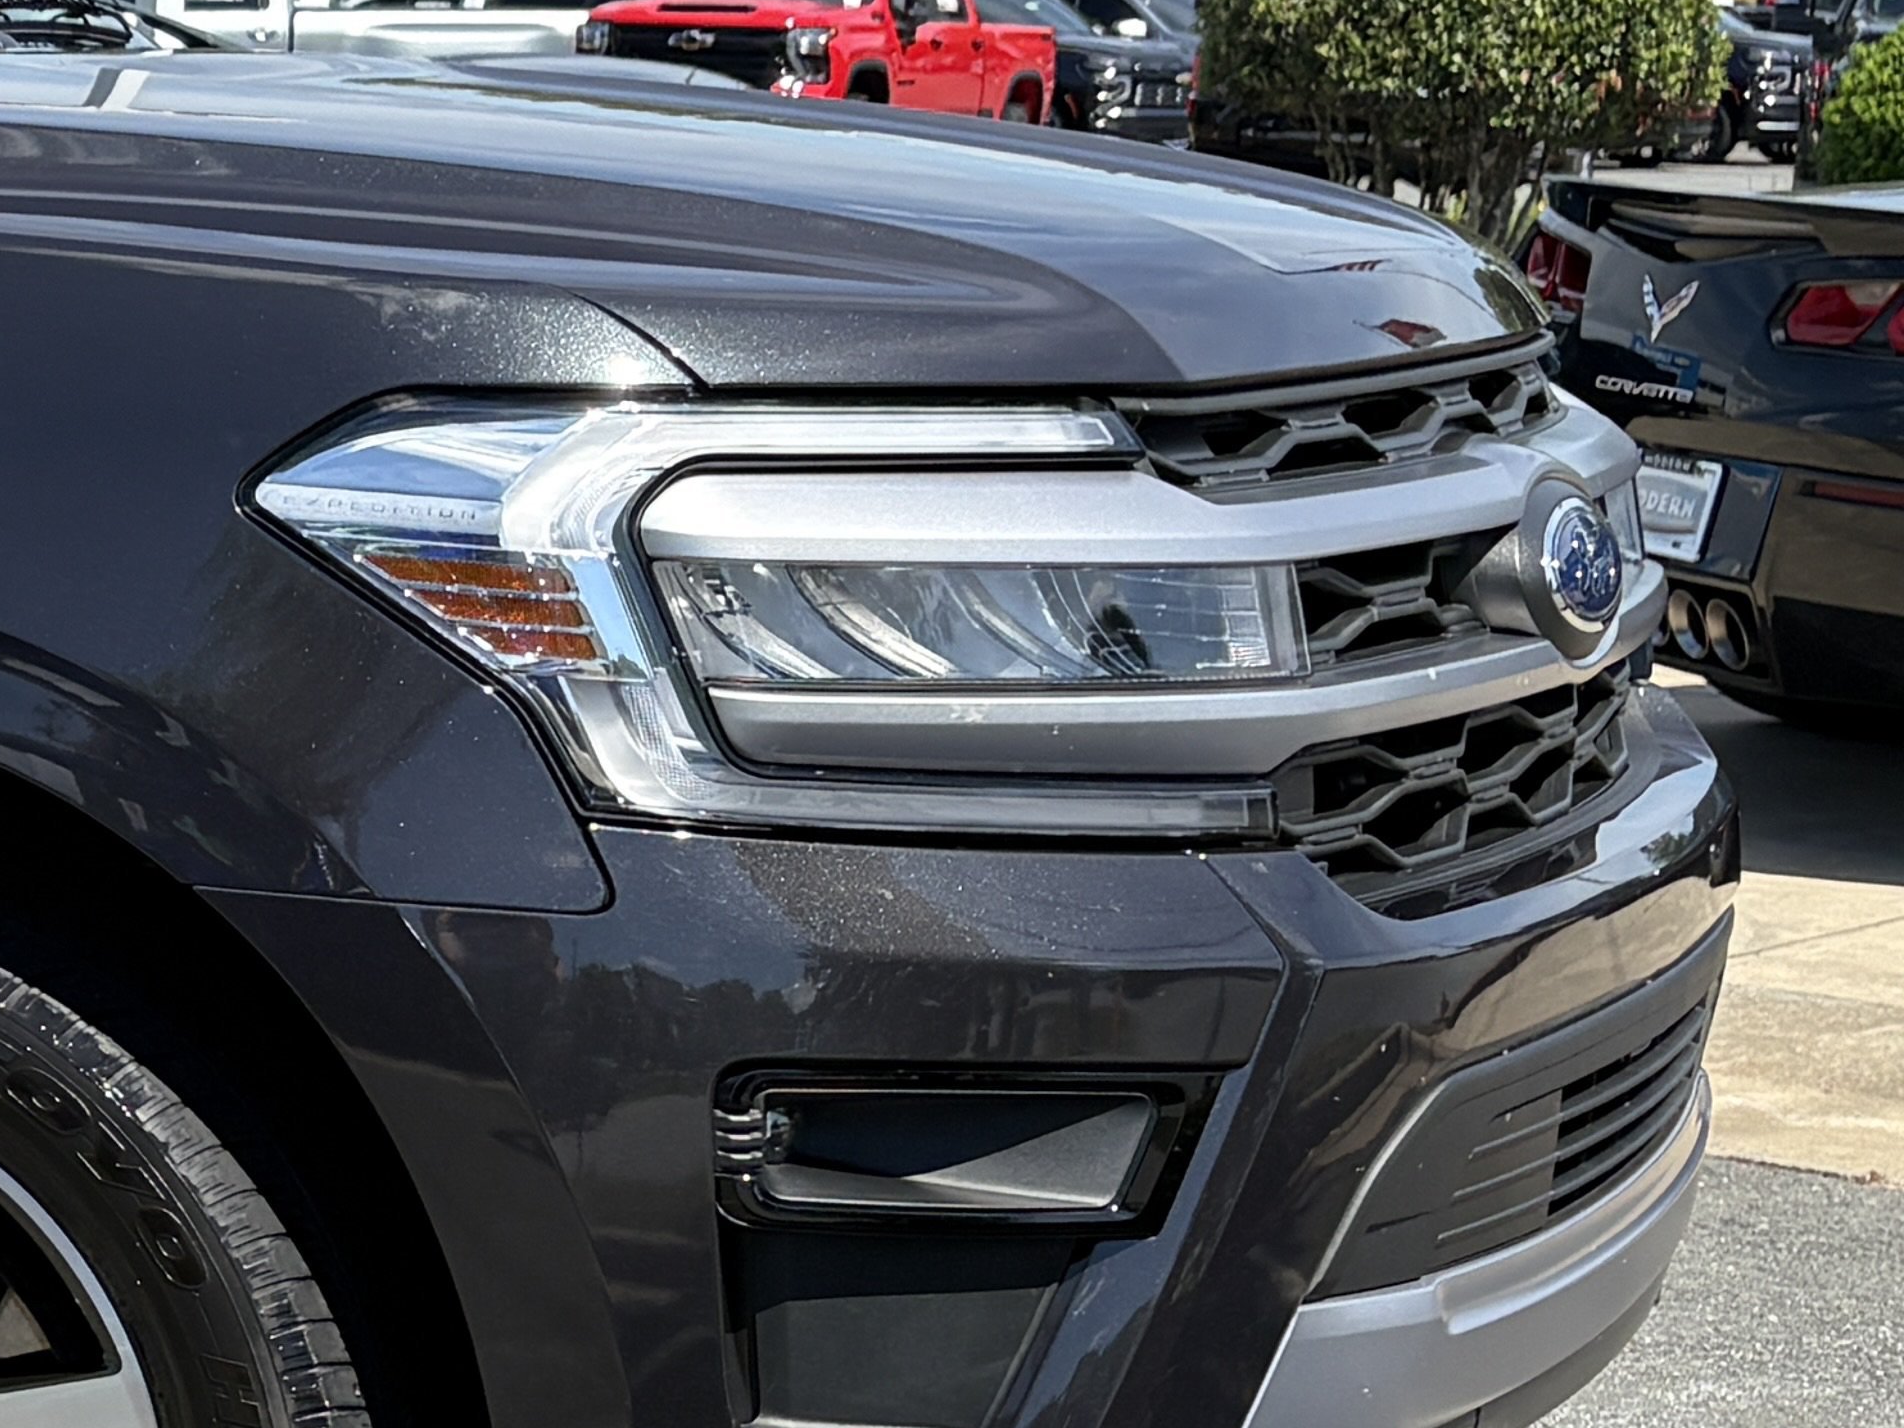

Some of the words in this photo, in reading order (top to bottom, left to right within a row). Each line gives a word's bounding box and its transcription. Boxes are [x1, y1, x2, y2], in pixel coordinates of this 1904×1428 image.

[1594, 374, 1694, 404] CORVETTE
[282, 494, 477, 522] EXPEDITION
[1639, 488, 1697, 519] ODERN
